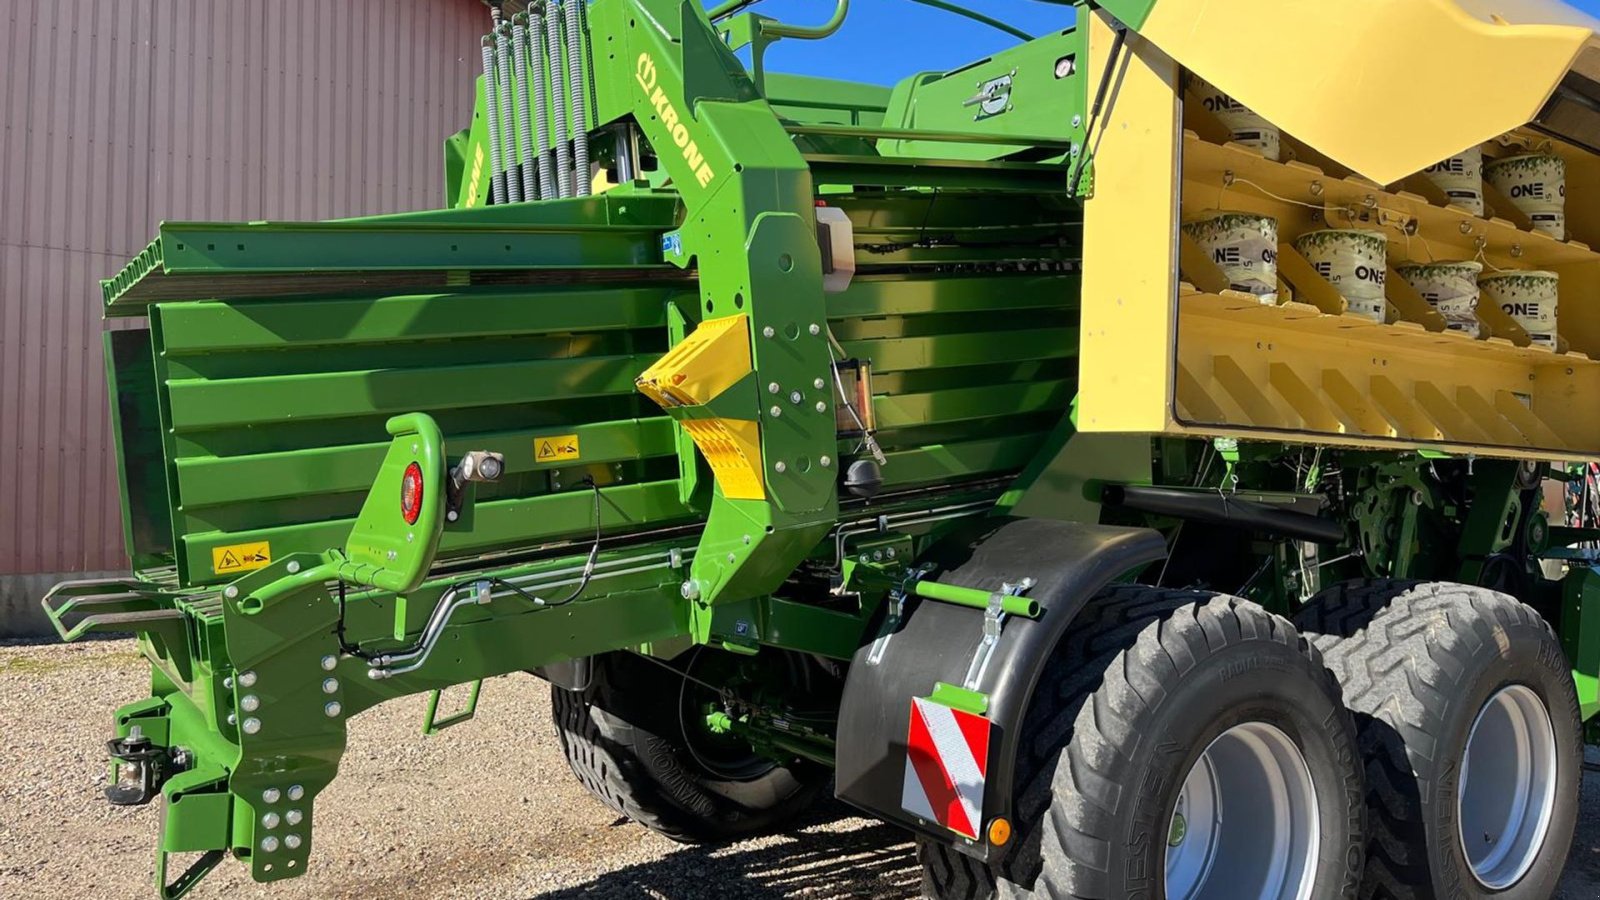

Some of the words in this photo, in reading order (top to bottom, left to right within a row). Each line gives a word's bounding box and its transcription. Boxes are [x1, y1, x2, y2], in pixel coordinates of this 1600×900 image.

[650, 85, 714, 189] KRONE
[1511, 182, 1543, 198] ONE
[1213, 247, 1239, 263] NE
[1502, 303, 1539, 316] ONE
